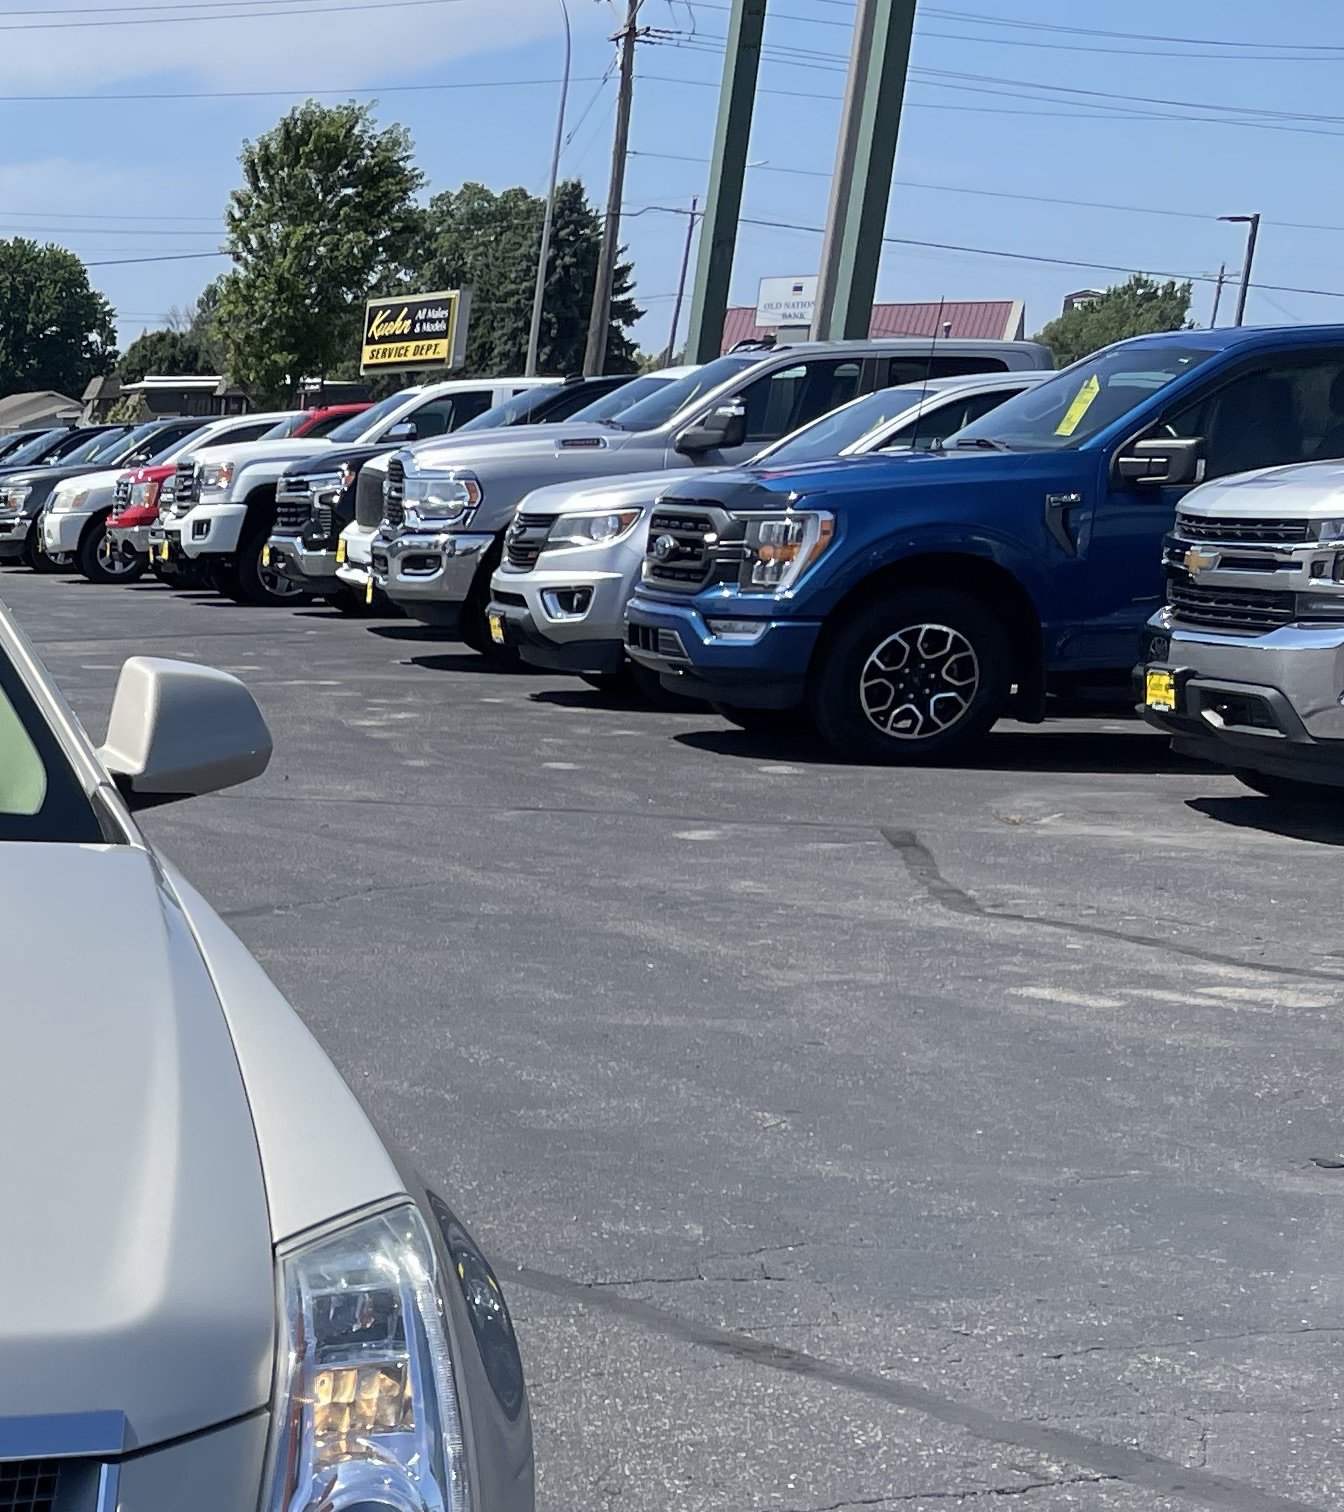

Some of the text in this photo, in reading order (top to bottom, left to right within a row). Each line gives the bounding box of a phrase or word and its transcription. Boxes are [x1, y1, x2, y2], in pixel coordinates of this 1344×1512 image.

[763, 301, 782, 310] OLD
[414, 306, 449, 320] All Makes
[781, 311, 806, 320] BANK
[368, 306, 412, 340] Kuehn
[413, 319, 447, 334] & Models
[369, 343, 441, 360] SERVICE DEPT.
